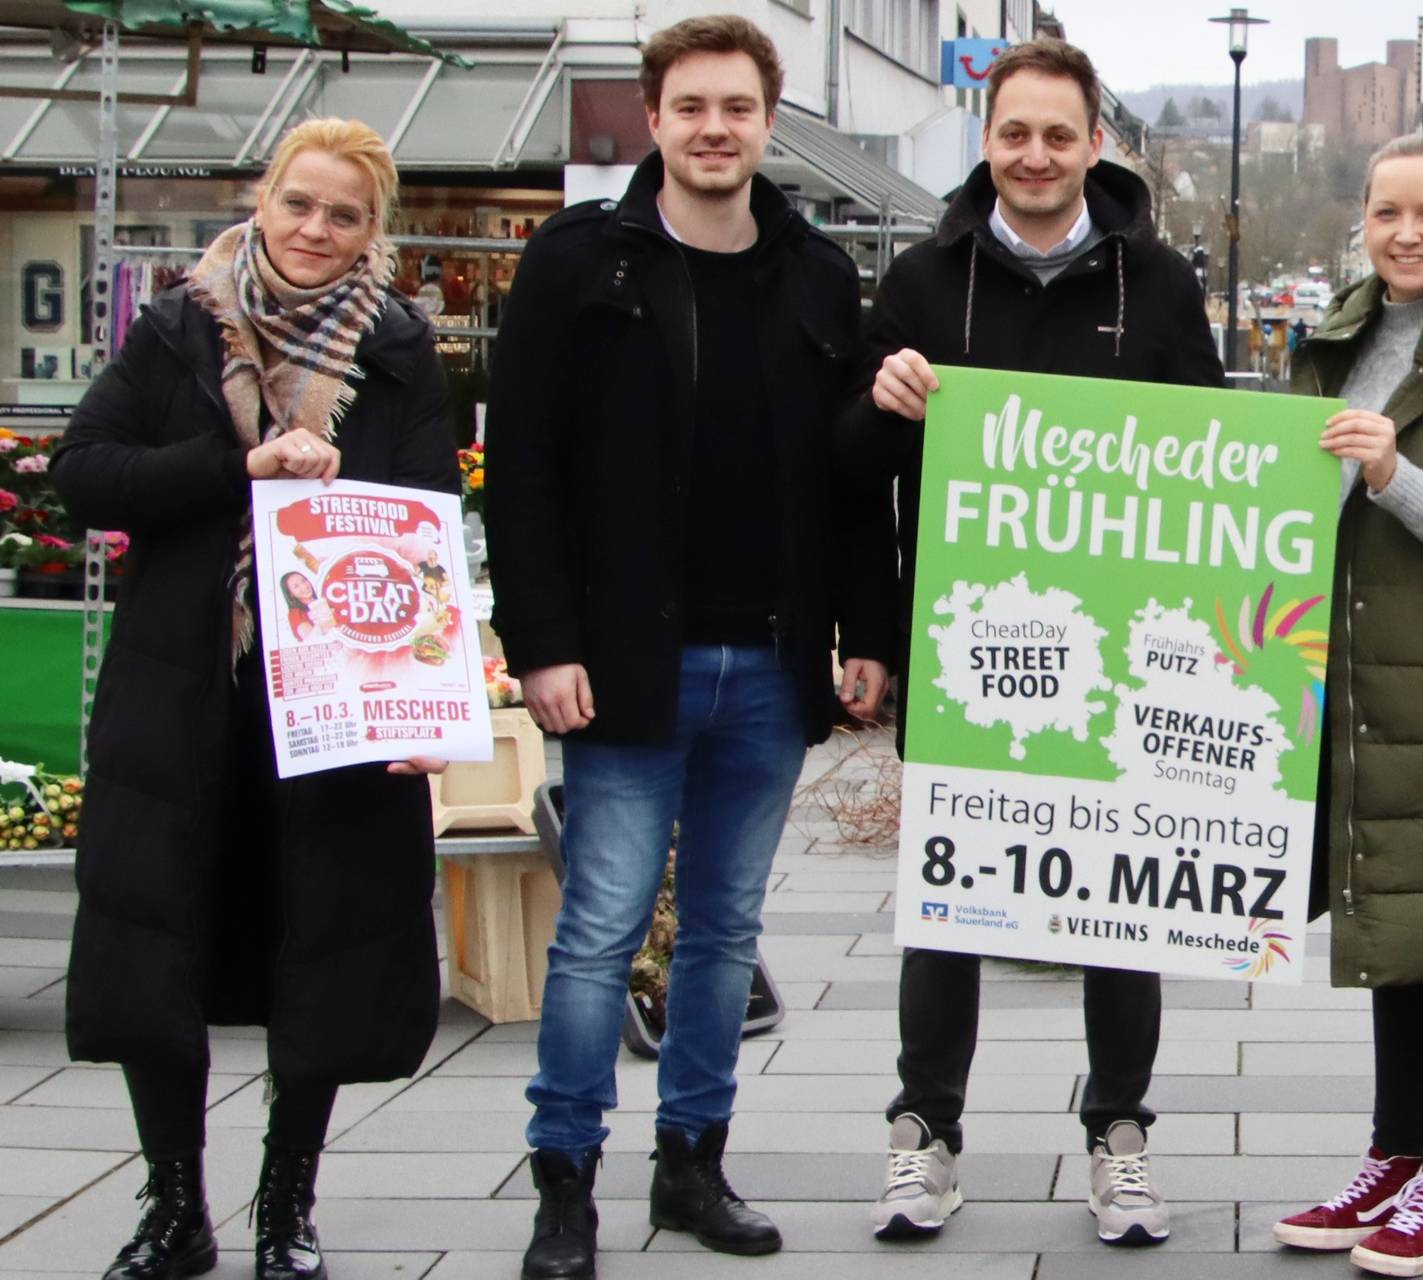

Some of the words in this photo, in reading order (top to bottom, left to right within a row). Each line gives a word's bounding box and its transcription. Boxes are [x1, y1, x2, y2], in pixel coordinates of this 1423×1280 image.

[982, 394, 1278, 490] Mescheder
[310, 496, 409, 521] STREETFOOD
[325, 515, 399, 537] FESTIVAL
[944, 474, 1315, 575] FRÜHLING
[326, 581, 414, 605] CHEAT
[350, 602, 402, 624] DAY
[971, 620, 1067, 643] CheatDay
[1143, 633, 1206, 657] Frühjahrs
[970, 646, 1070, 672] STREET
[1145, 653, 1199, 676] PUTZ
[982, 674, 1060, 698] FOOD
[363, 700, 471, 721] MESCHEDE
[287, 727, 313, 739] FREITAG
[375, 726, 437, 739] STIFTSPLATZ
[1133, 704, 1273, 746] VERKAUFS-
[288, 736, 319, 749] SAMSTAG
[289, 745, 320, 759] SONNTAG
[1143, 732, 1256, 771] OFFENER
[1154, 760, 1236, 794] Sonntag
[929, 783, 1056, 836] Freitag
[1070, 795, 1119, 833] bis
[1133, 803, 1289, 857] Sonntag
[921, 836, 1090, 901] 8.-10.
[1108, 847, 1287, 920] MÄRZ
[954, 915, 1003, 929] Sauerland
[1005, 920, 1019, 931] eG
[955, 904, 1008, 918] Volksbank
[1067, 916, 1149, 942] VELTINS
[1167, 929, 1260, 953] Meschede
